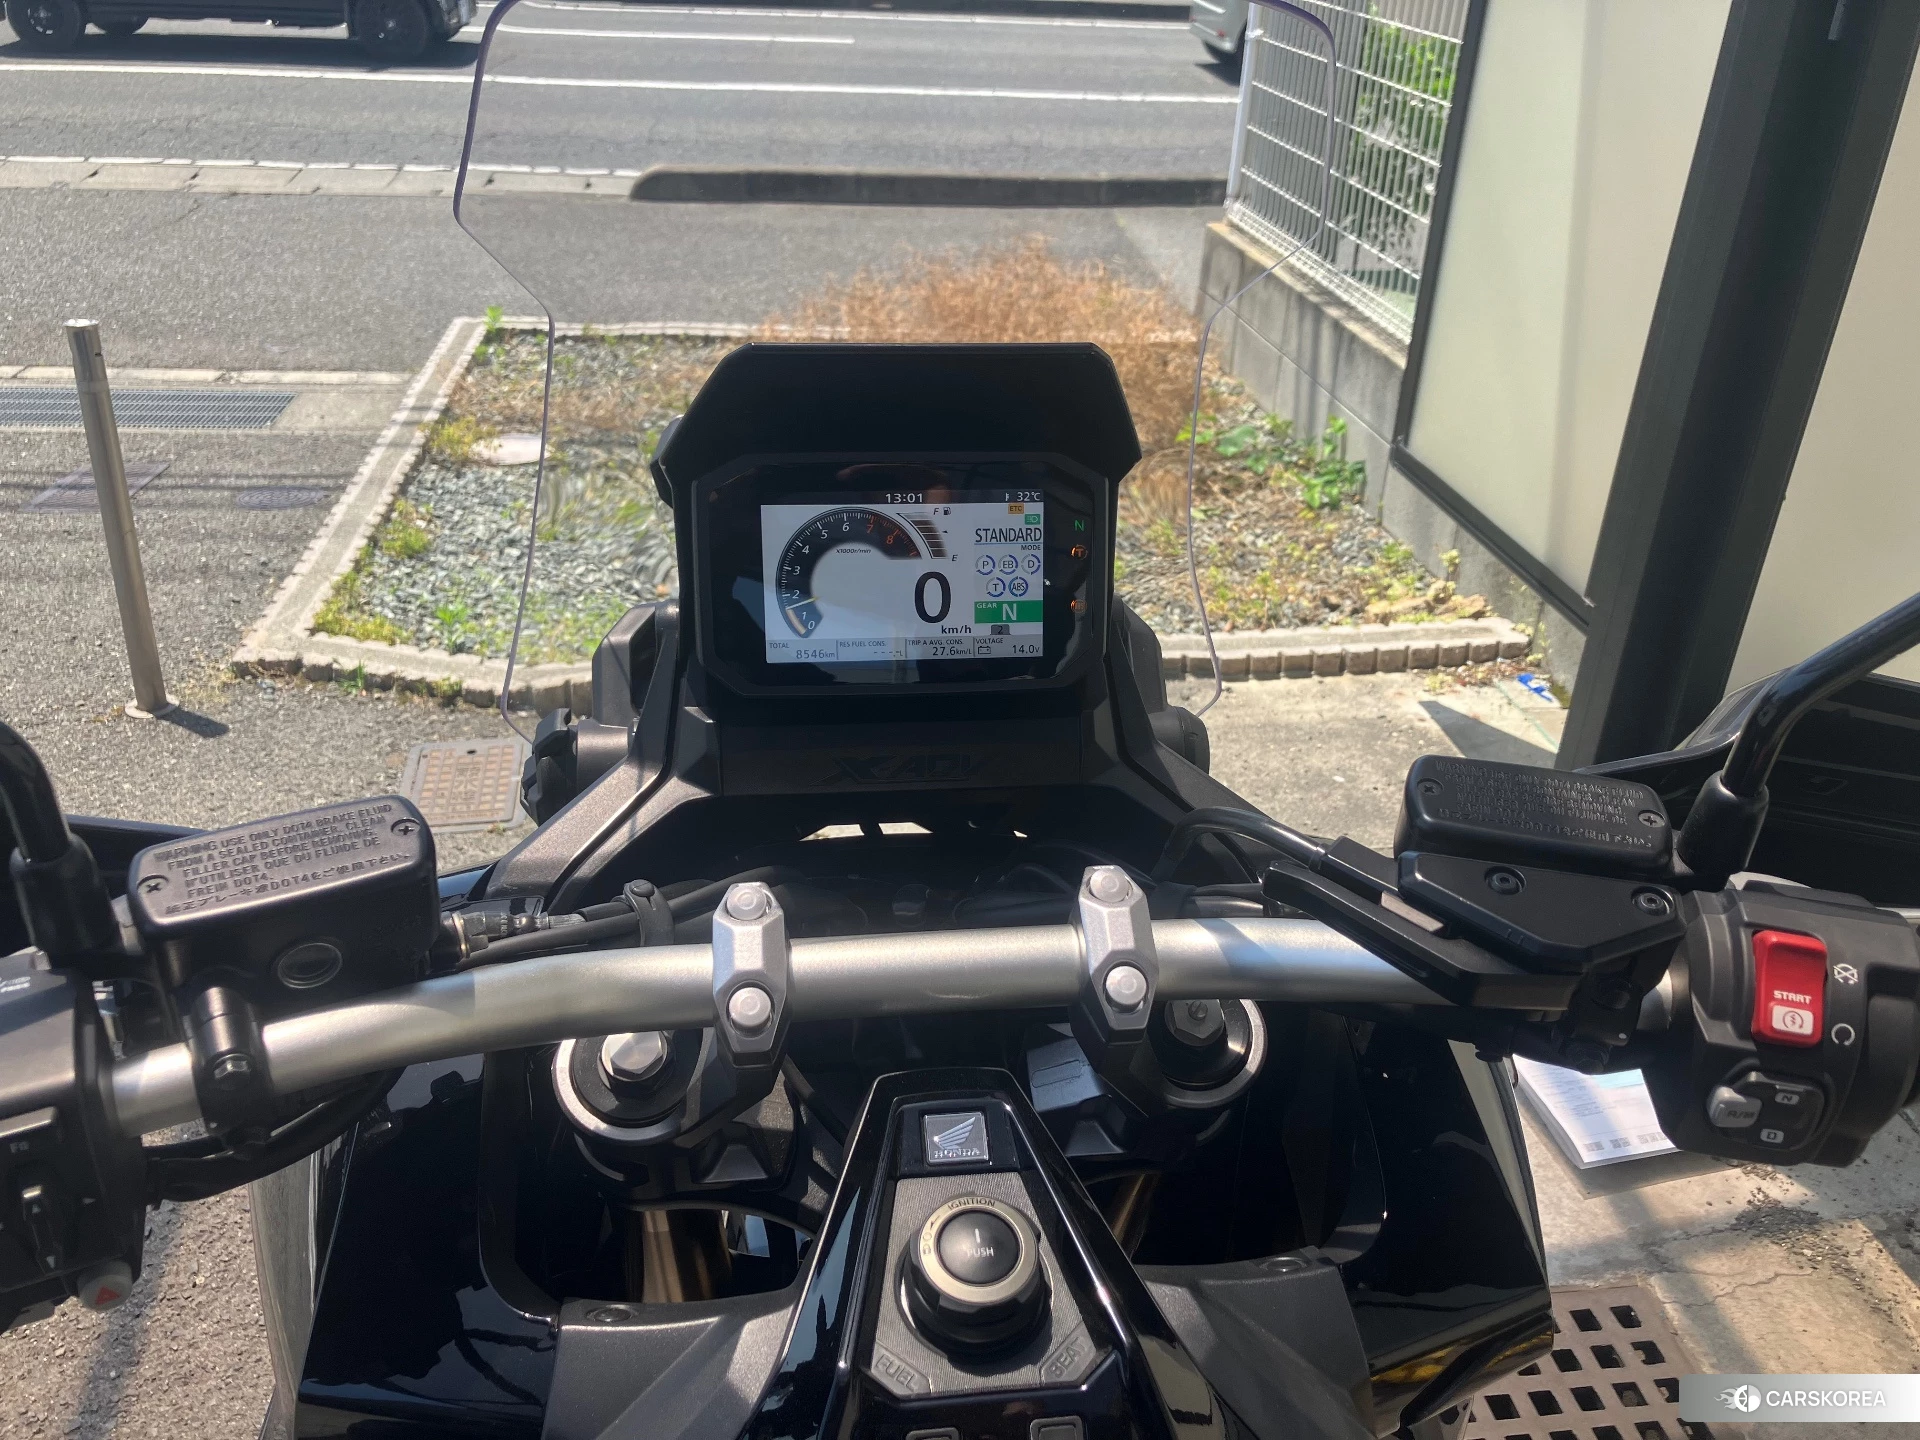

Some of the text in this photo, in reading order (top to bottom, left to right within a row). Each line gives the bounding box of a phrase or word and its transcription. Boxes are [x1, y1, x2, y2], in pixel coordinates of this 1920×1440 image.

[885, 493, 923, 504] 13:01
[933, 507, 940, 515] F
[842, 522, 850, 532] 6
[866, 524, 873, 534] 7
[1074, 519, 1085, 531] N
[820, 529, 828, 539] 5
[975, 527, 1042, 543] STANDARD
[886, 535, 894, 545] 8
[801, 545, 810, 555] 4
[951, 554, 958, 562] E
[982, 560, 1035, 569] P EB D
[792, 565, 800, 575] 3
[1012, 582, 1026, 592] ABS
[792, 589, 800, 599] 2
[914, 571, 951, 623] 0
[801, 611, 807, 620] 1
[1002, 603, 1017, 621] N
[807, 620, 815, 630] 0
[941, 624, 972, 635] km/h
[975, 637, 1003, 645] VOLTAGE
[221, 835, 246, 848] USE
[1773, 990, 1812, 1005] START
[934, 1147, 981, 1159] HONDA
[947, 1197, 995, 1210] IGNITION
[966, 1246, 995, 1258] PUSH
[1050, 1339, 1088, 1379] SEAT
[875, 1353, 919, 1390] FUEL
